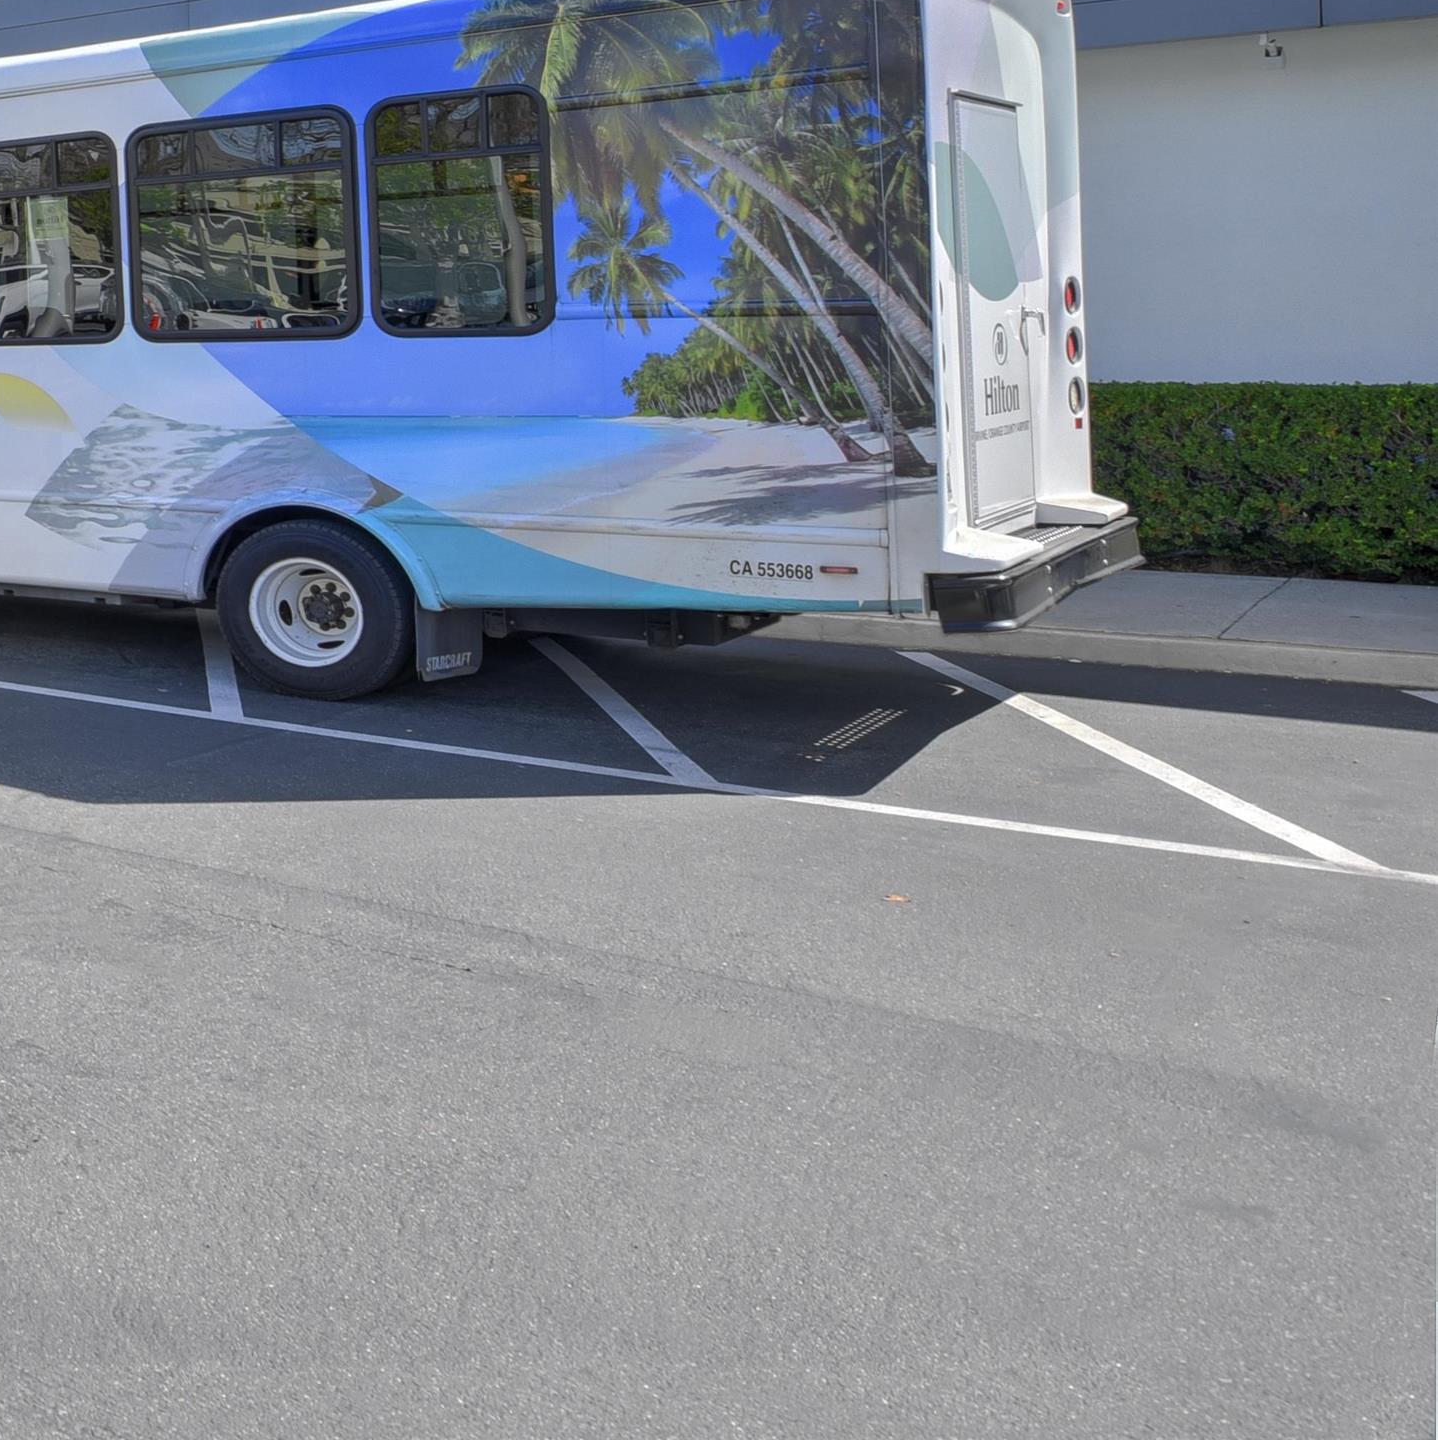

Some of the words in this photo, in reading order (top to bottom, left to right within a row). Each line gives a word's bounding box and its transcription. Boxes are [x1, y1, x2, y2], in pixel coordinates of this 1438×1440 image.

[984, 375, 1021, 417] Hilton
[730, 560, 753, 576] CA
[757, 562, 814, 580] 553668
[426, 651, 472, 672] STARCRAFT
